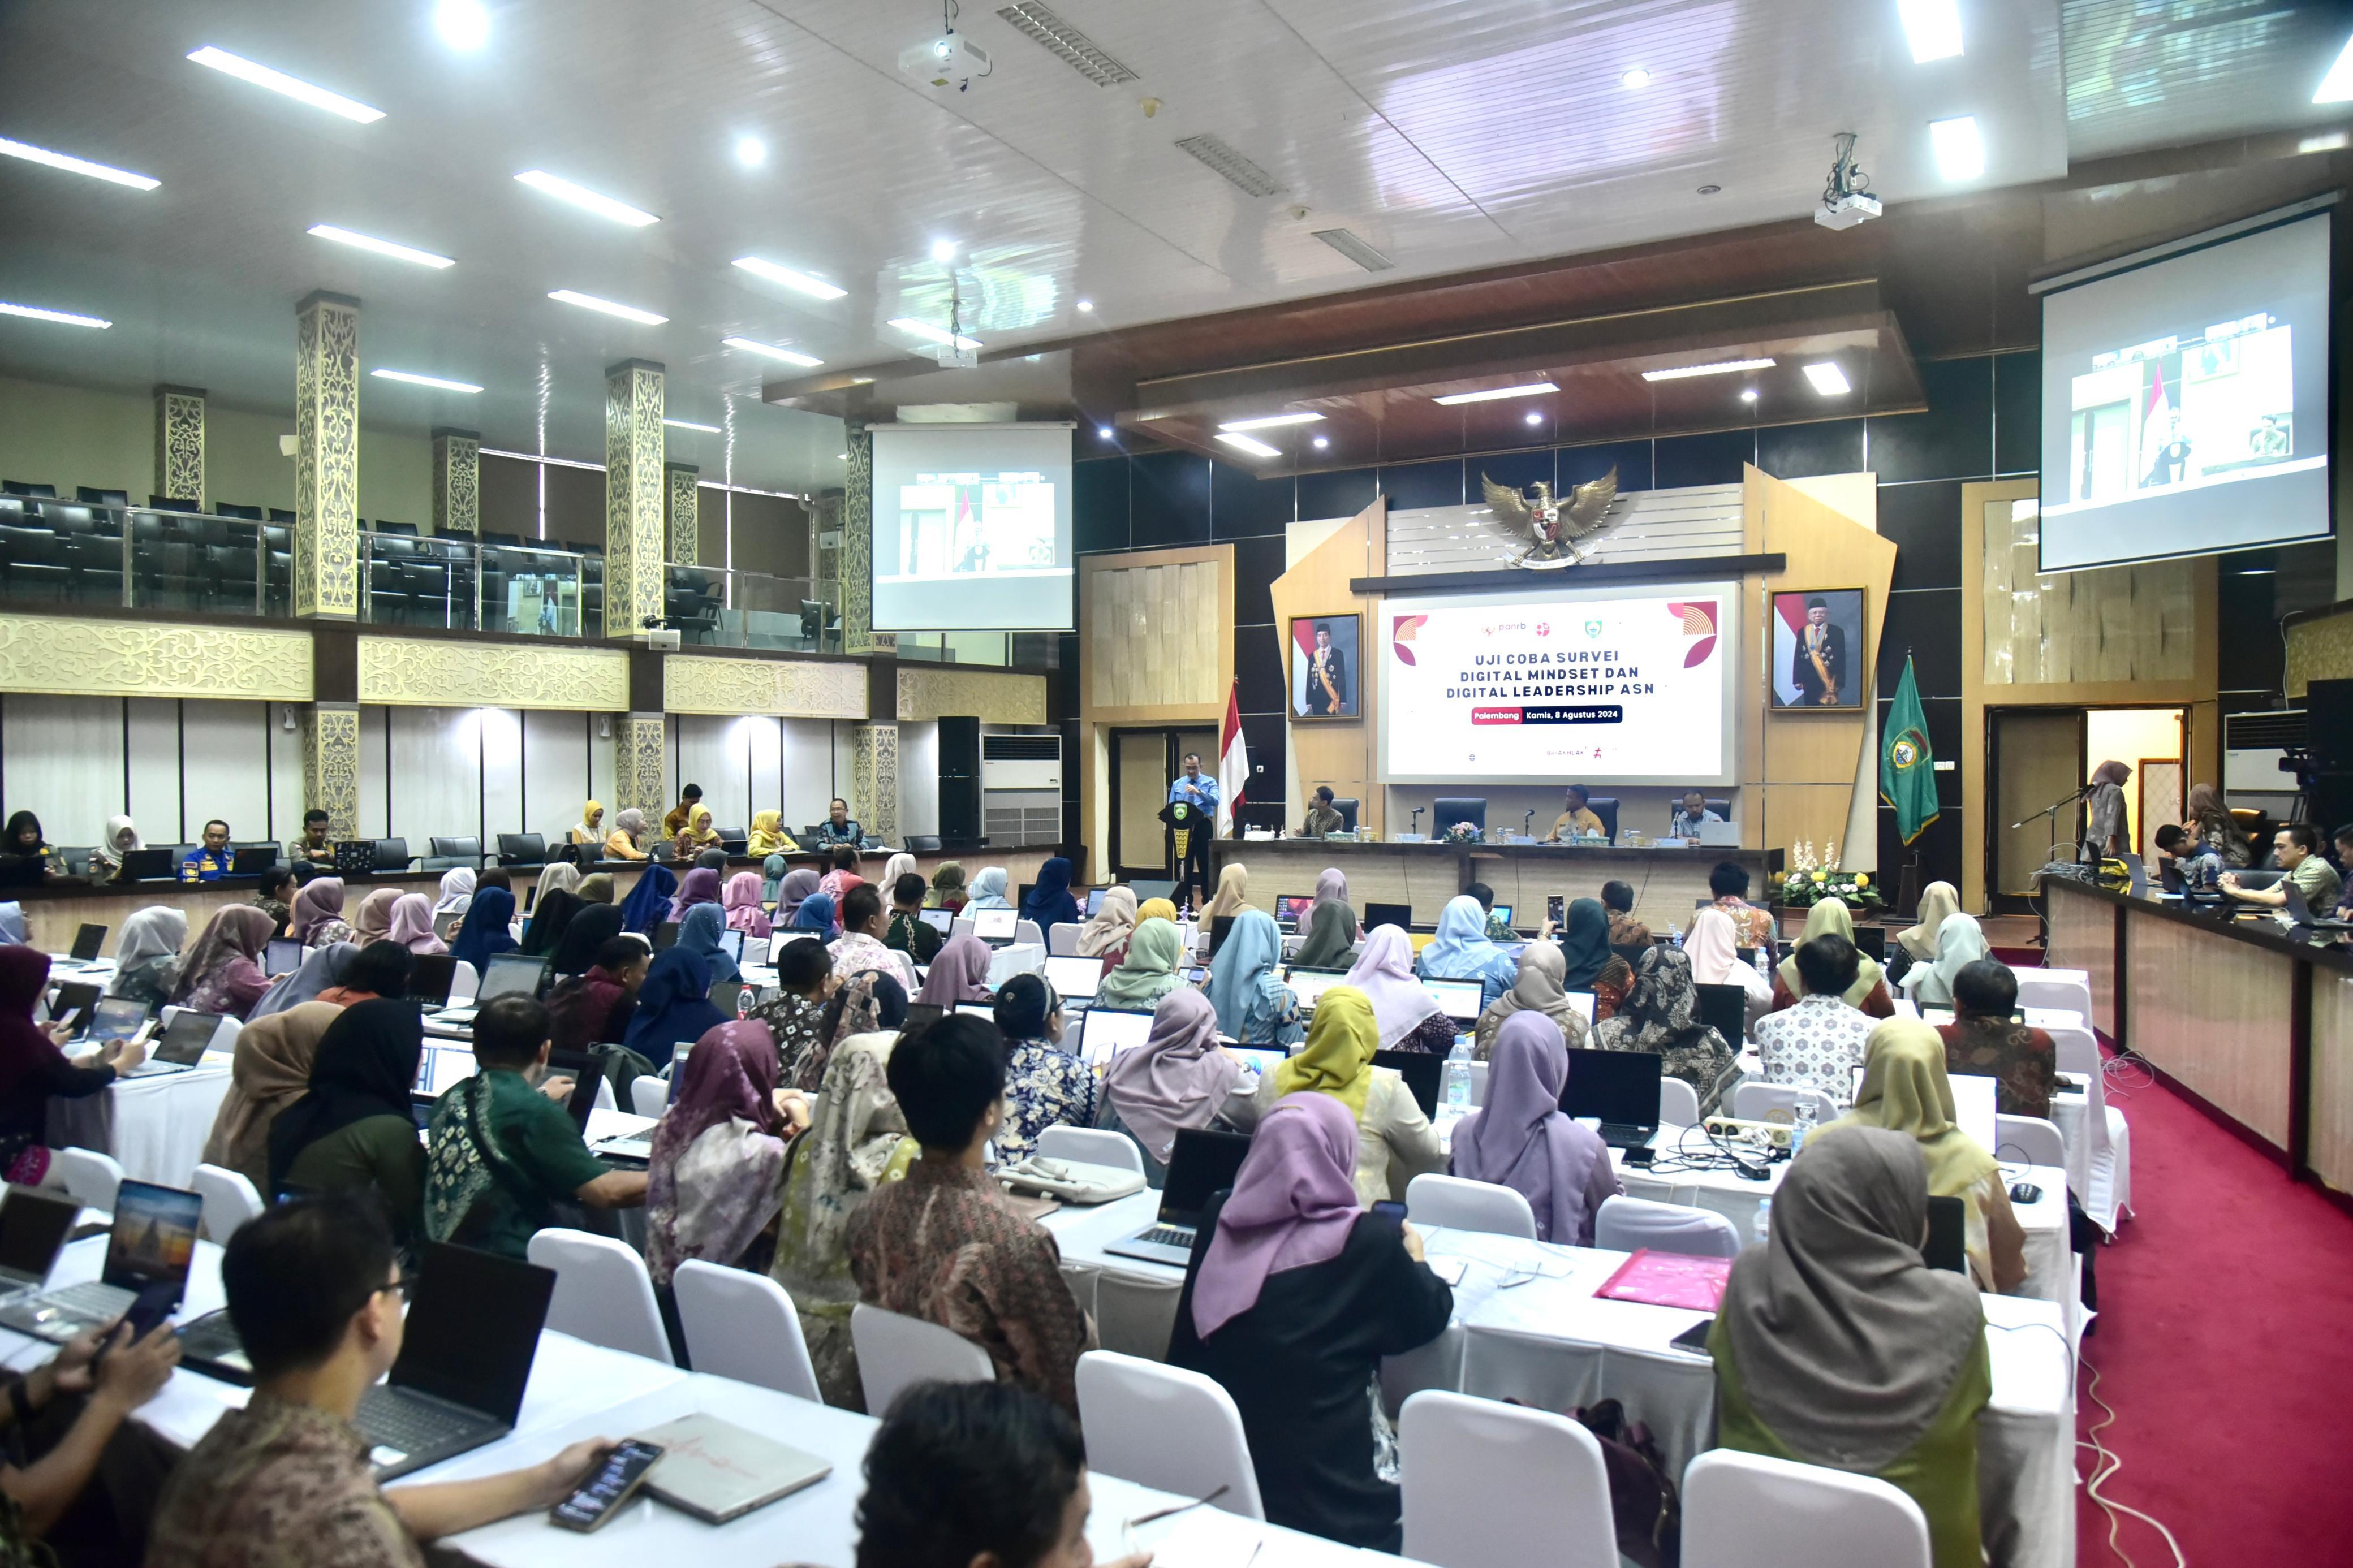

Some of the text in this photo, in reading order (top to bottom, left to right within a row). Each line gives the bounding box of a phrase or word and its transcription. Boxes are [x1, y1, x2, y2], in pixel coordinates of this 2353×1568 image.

[1475, 650, 1618, 666] UJI COBA SURVEI
[1460, 667, 1639, 682] DIGITAL MINDSET DAN
[1447, 683, 1654, 698] DIGITAL LEADERSHIP ASN
[1474, 712, 1519, 721] Palembang
[1562, 711, 1596, 720] Agustus
